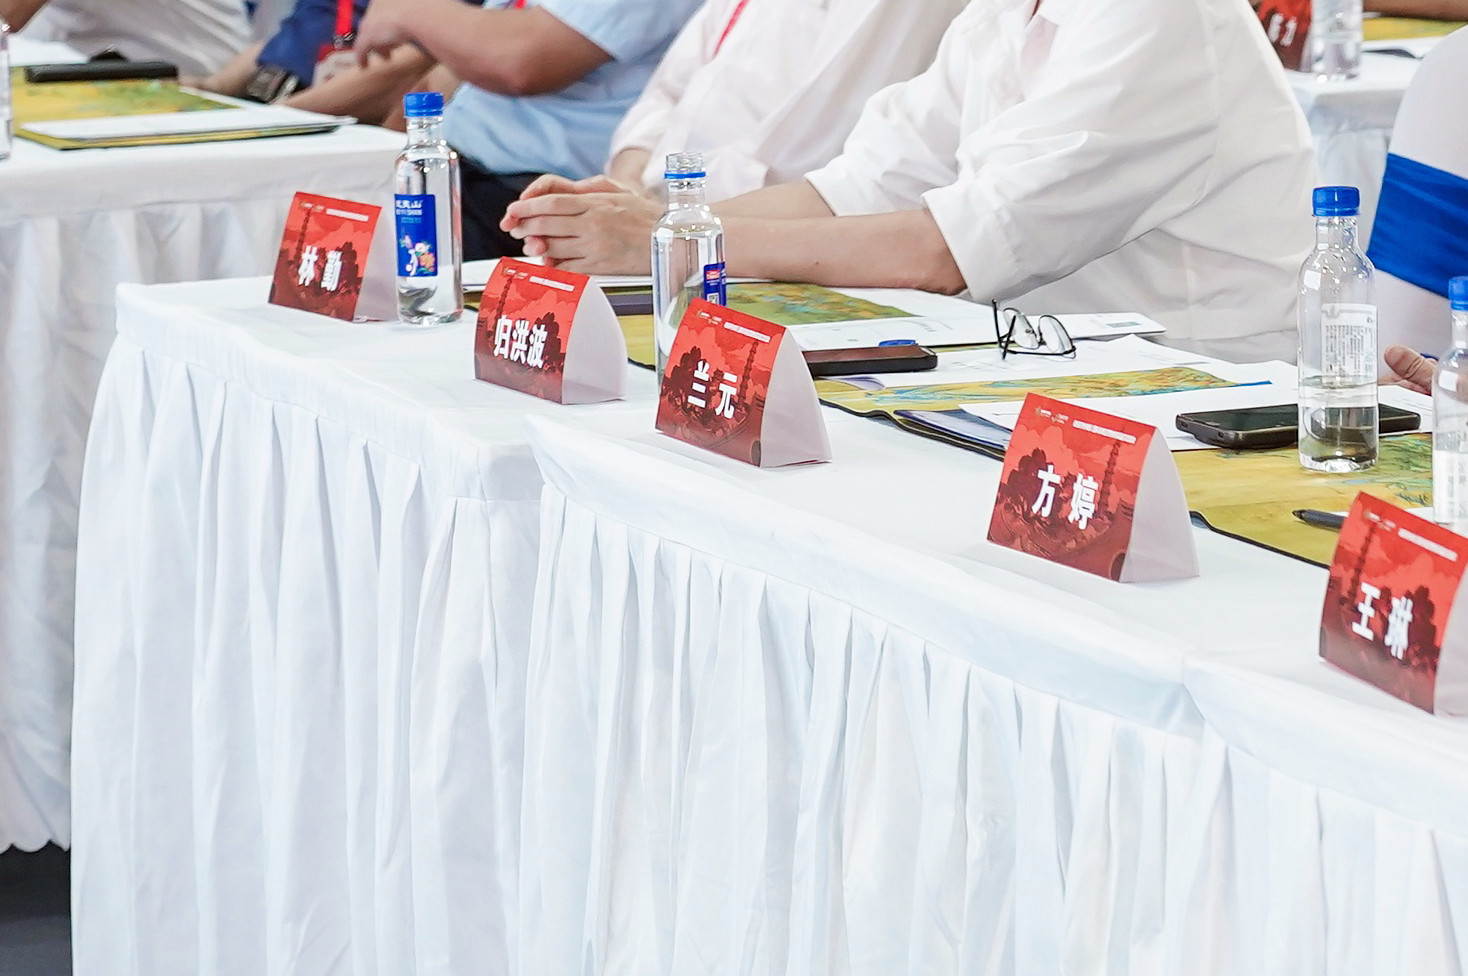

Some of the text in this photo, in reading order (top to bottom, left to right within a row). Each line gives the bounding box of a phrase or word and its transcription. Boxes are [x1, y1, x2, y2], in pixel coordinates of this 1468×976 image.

[493, 314, 548, 369] 归洪波
[687, 360, 739, 420] 兰元
[1031, 464, 1099, 531] 方婷
